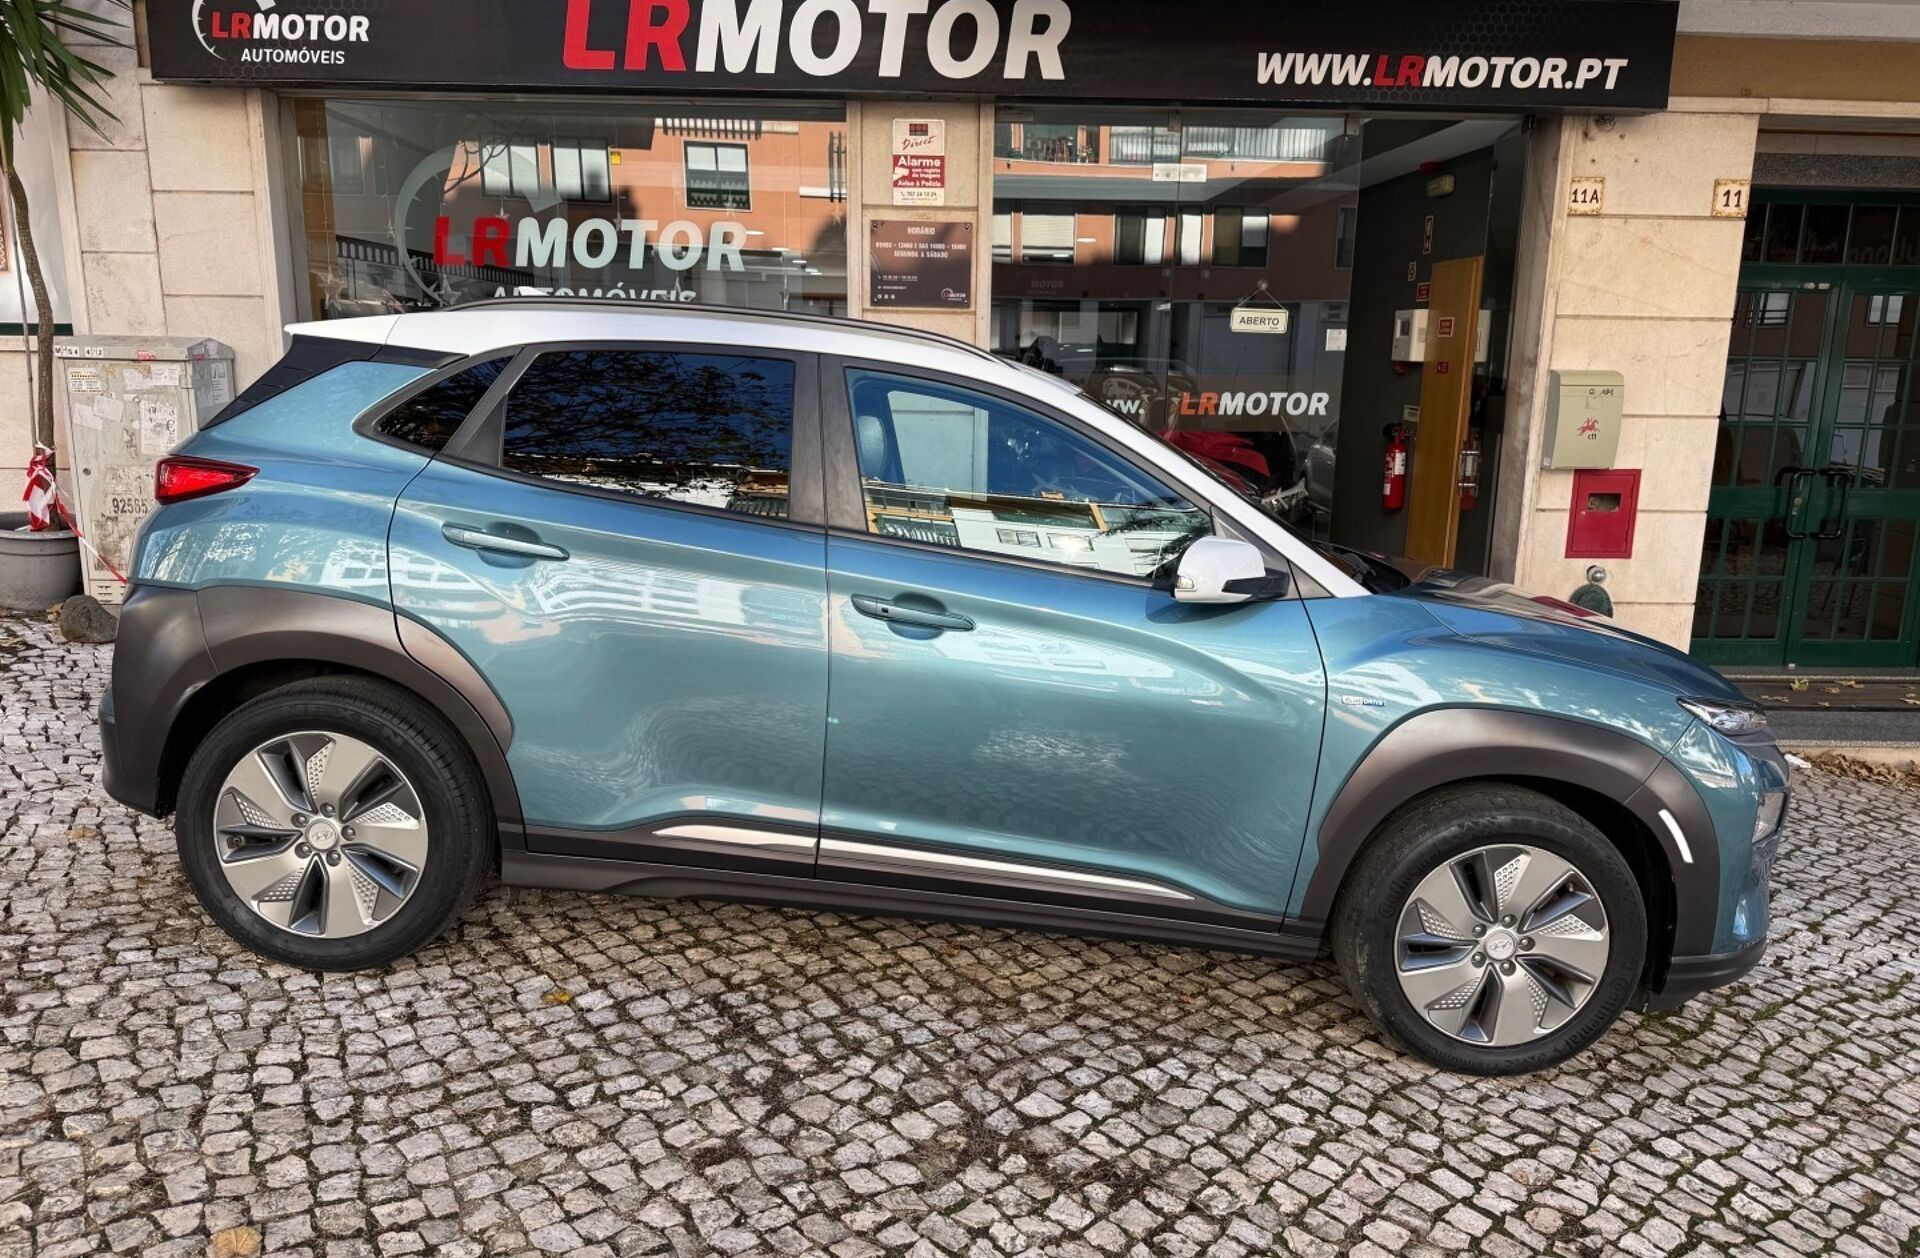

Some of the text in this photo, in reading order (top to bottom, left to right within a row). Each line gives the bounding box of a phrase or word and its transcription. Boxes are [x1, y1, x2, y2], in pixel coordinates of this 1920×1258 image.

[212, 12, 370, 42] LRMOTOR
[563, 0, 1072, 80] LRMOTOR
[241, 47, 345, 64] AUTOMÓVEIS
[1256, 53, 1628, 90] WWW.LRMOTOR.PT
[898, 155, 941, 167] Alarme
[1571, 188, 1599, 203] 11A
[1722, 189, 1743, 207] 11
[907, 226, 935, 235] HORÁRIO
[433, 217, 747, 272] LRMOTOR
[894, 250, 918, 258] SEGUNDA
[1239, 316, 1280, 326] ABERTO
[1180, 391, 1329, 416] LRMOTOR
